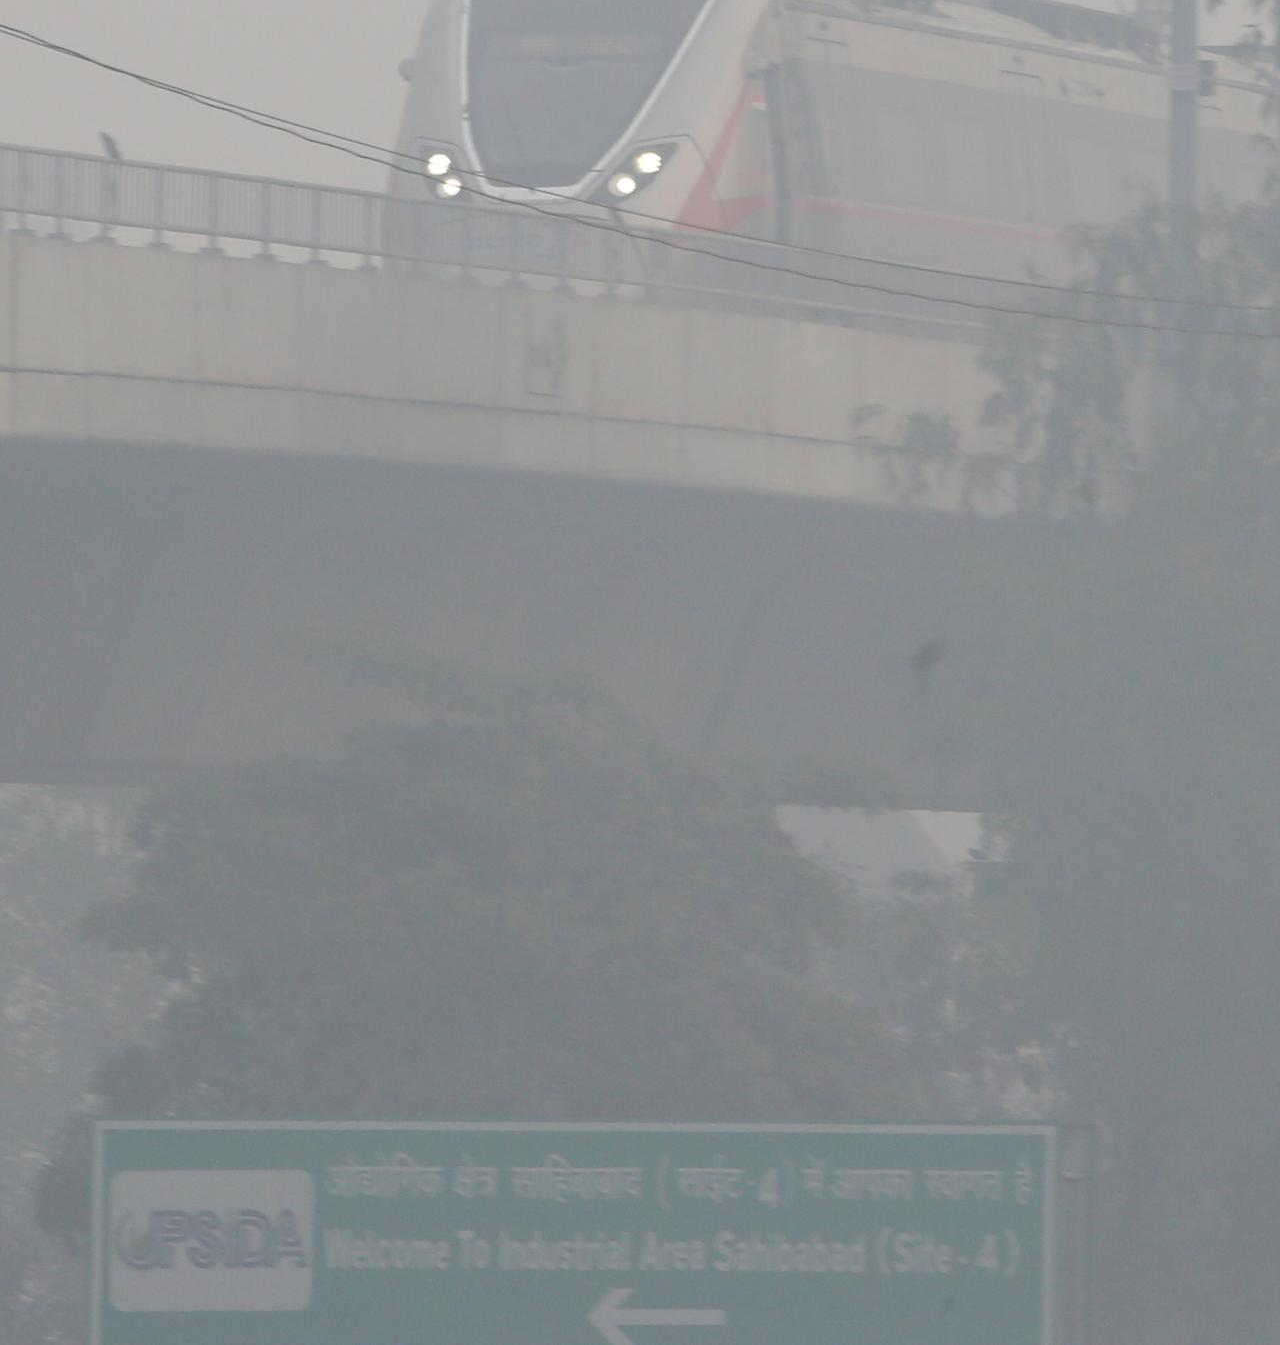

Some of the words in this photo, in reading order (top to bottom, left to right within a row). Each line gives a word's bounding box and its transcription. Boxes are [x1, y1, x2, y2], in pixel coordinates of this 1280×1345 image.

[1014, 1155, 1032, 1205] है
[322, 1229, 451, 1270] Welcome
[455, 1230, 493, 1271] To
[498, 1229, 630, 1271] Industrial
[639, 1230, 706, 1272] Area
[715, 1229, 866, 1273] Sahibabad
